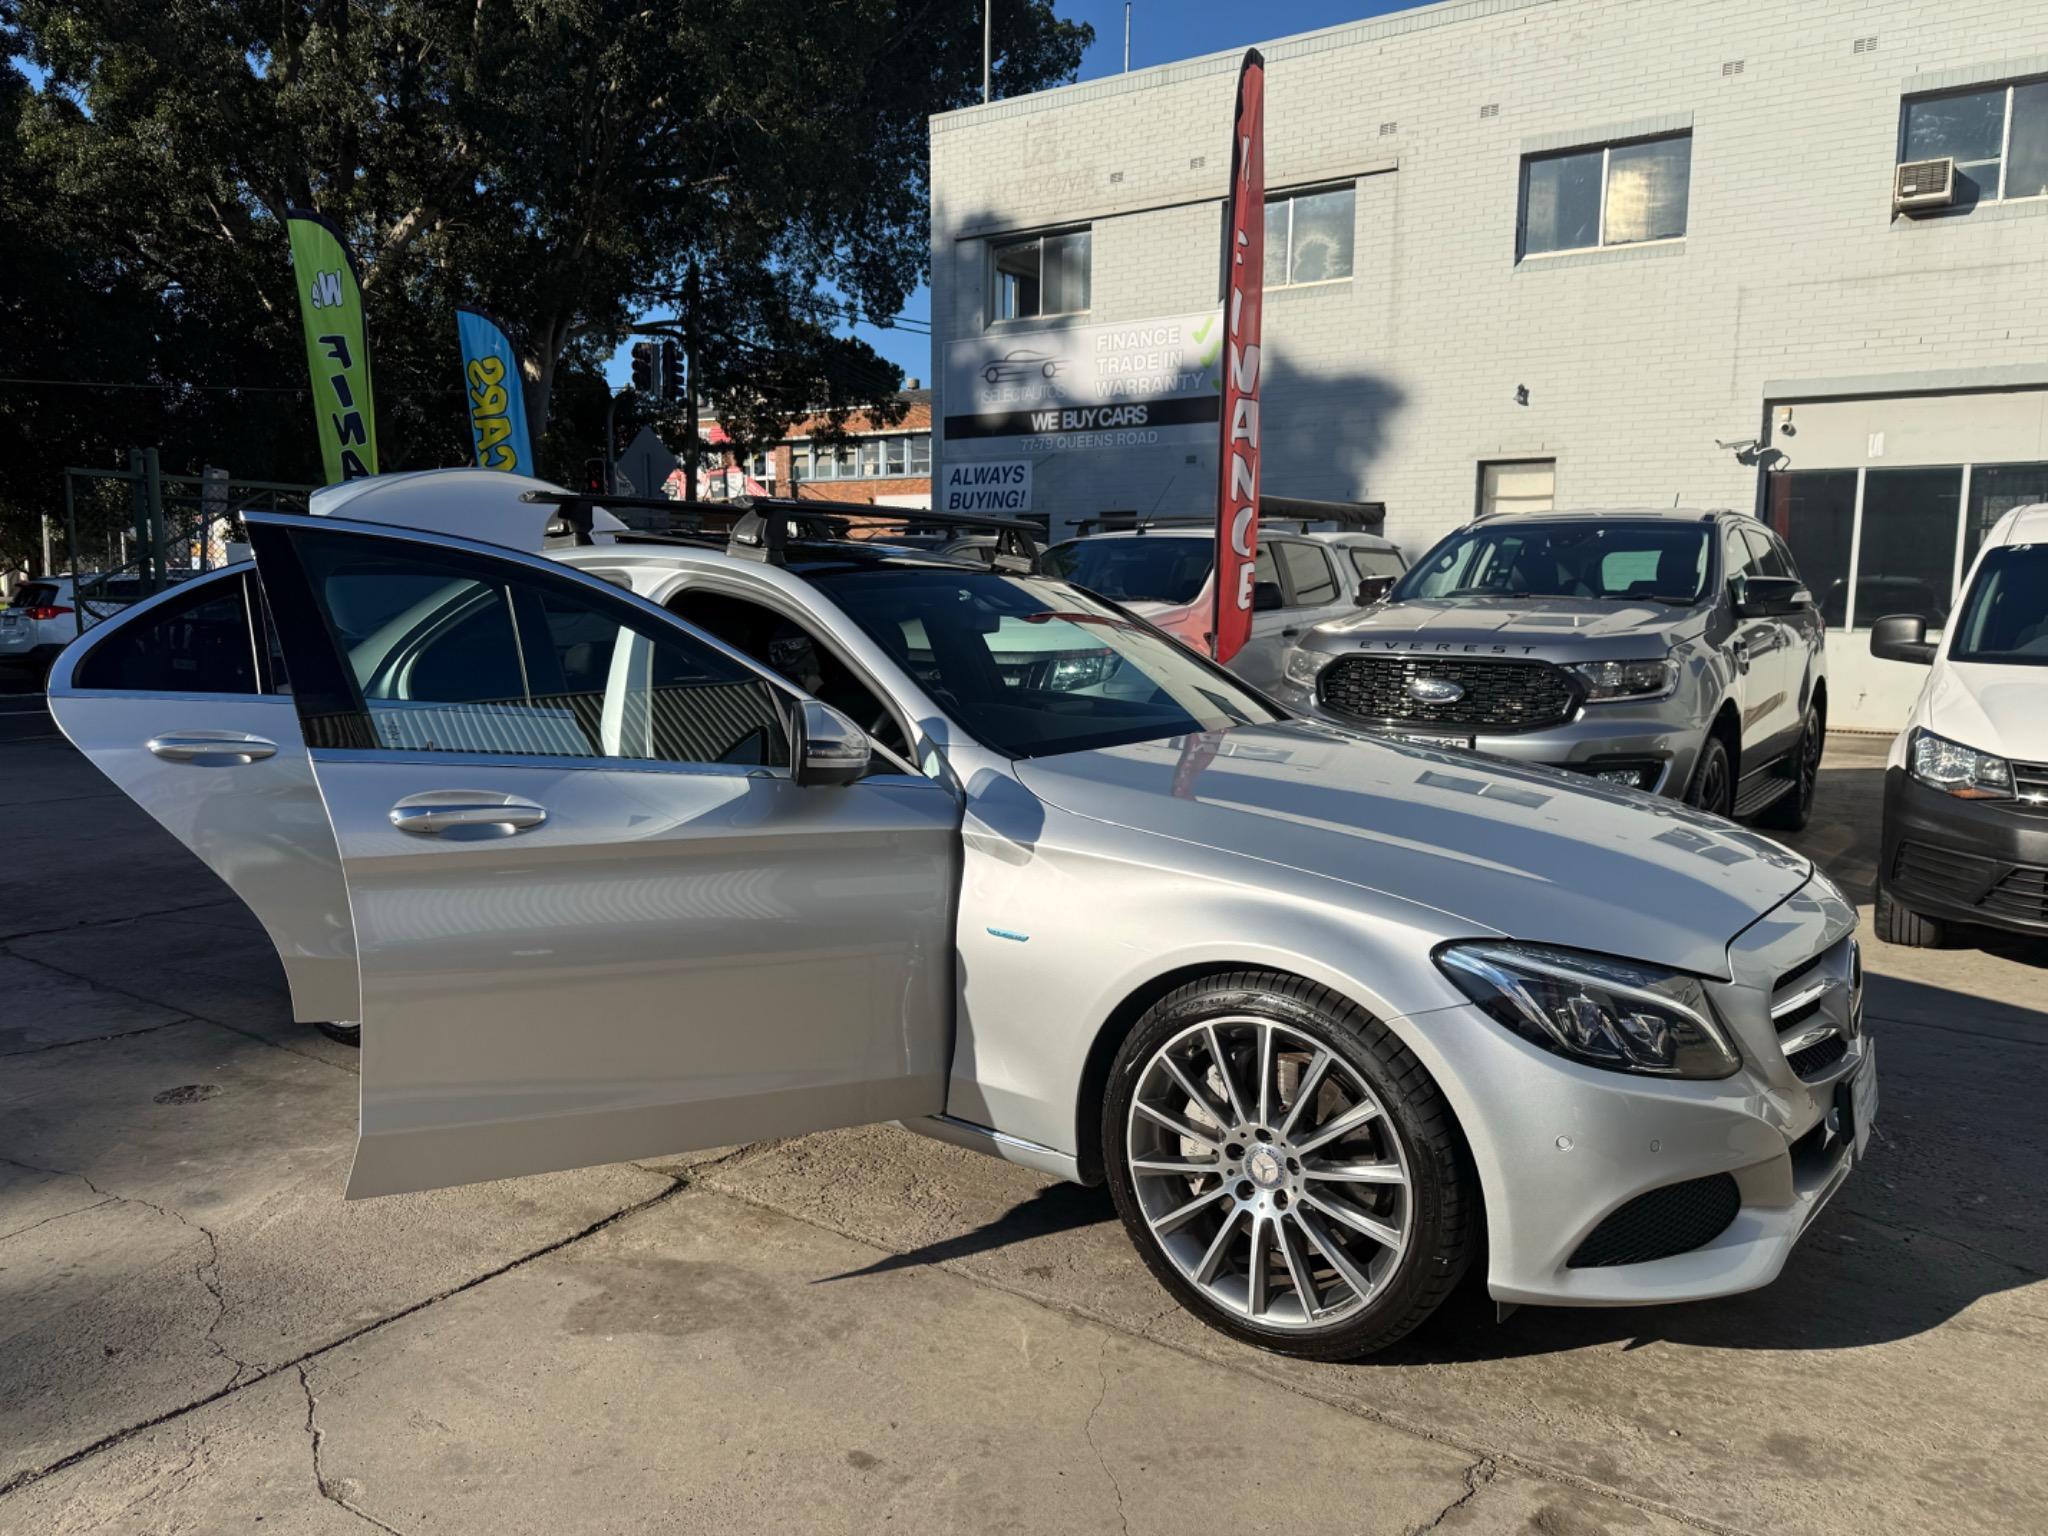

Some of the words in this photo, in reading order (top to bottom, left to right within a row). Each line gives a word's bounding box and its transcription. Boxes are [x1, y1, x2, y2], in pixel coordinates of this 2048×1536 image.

[1095, 326, 1182, 353] FINANCE
[1095, 352, 1159, 375] TRADE
[1162, 350, 1184, 371] IN
[1095, 371, 1206, 399] WARRANTY
[1031, 411, 1060, 432] WE
[1062, 407, 1097, 430] BUY
[1097, 404, 1149, 428] CARS
[1056, 433, 1114, 450] QUEENS
[1117, 431, 1159, 447] ROAD
[949, 464, 1026, 487] ALWAYS
[949, 489, 1027, 511] BUYING!
[1359, 640, 1538, 655] EVEREST
